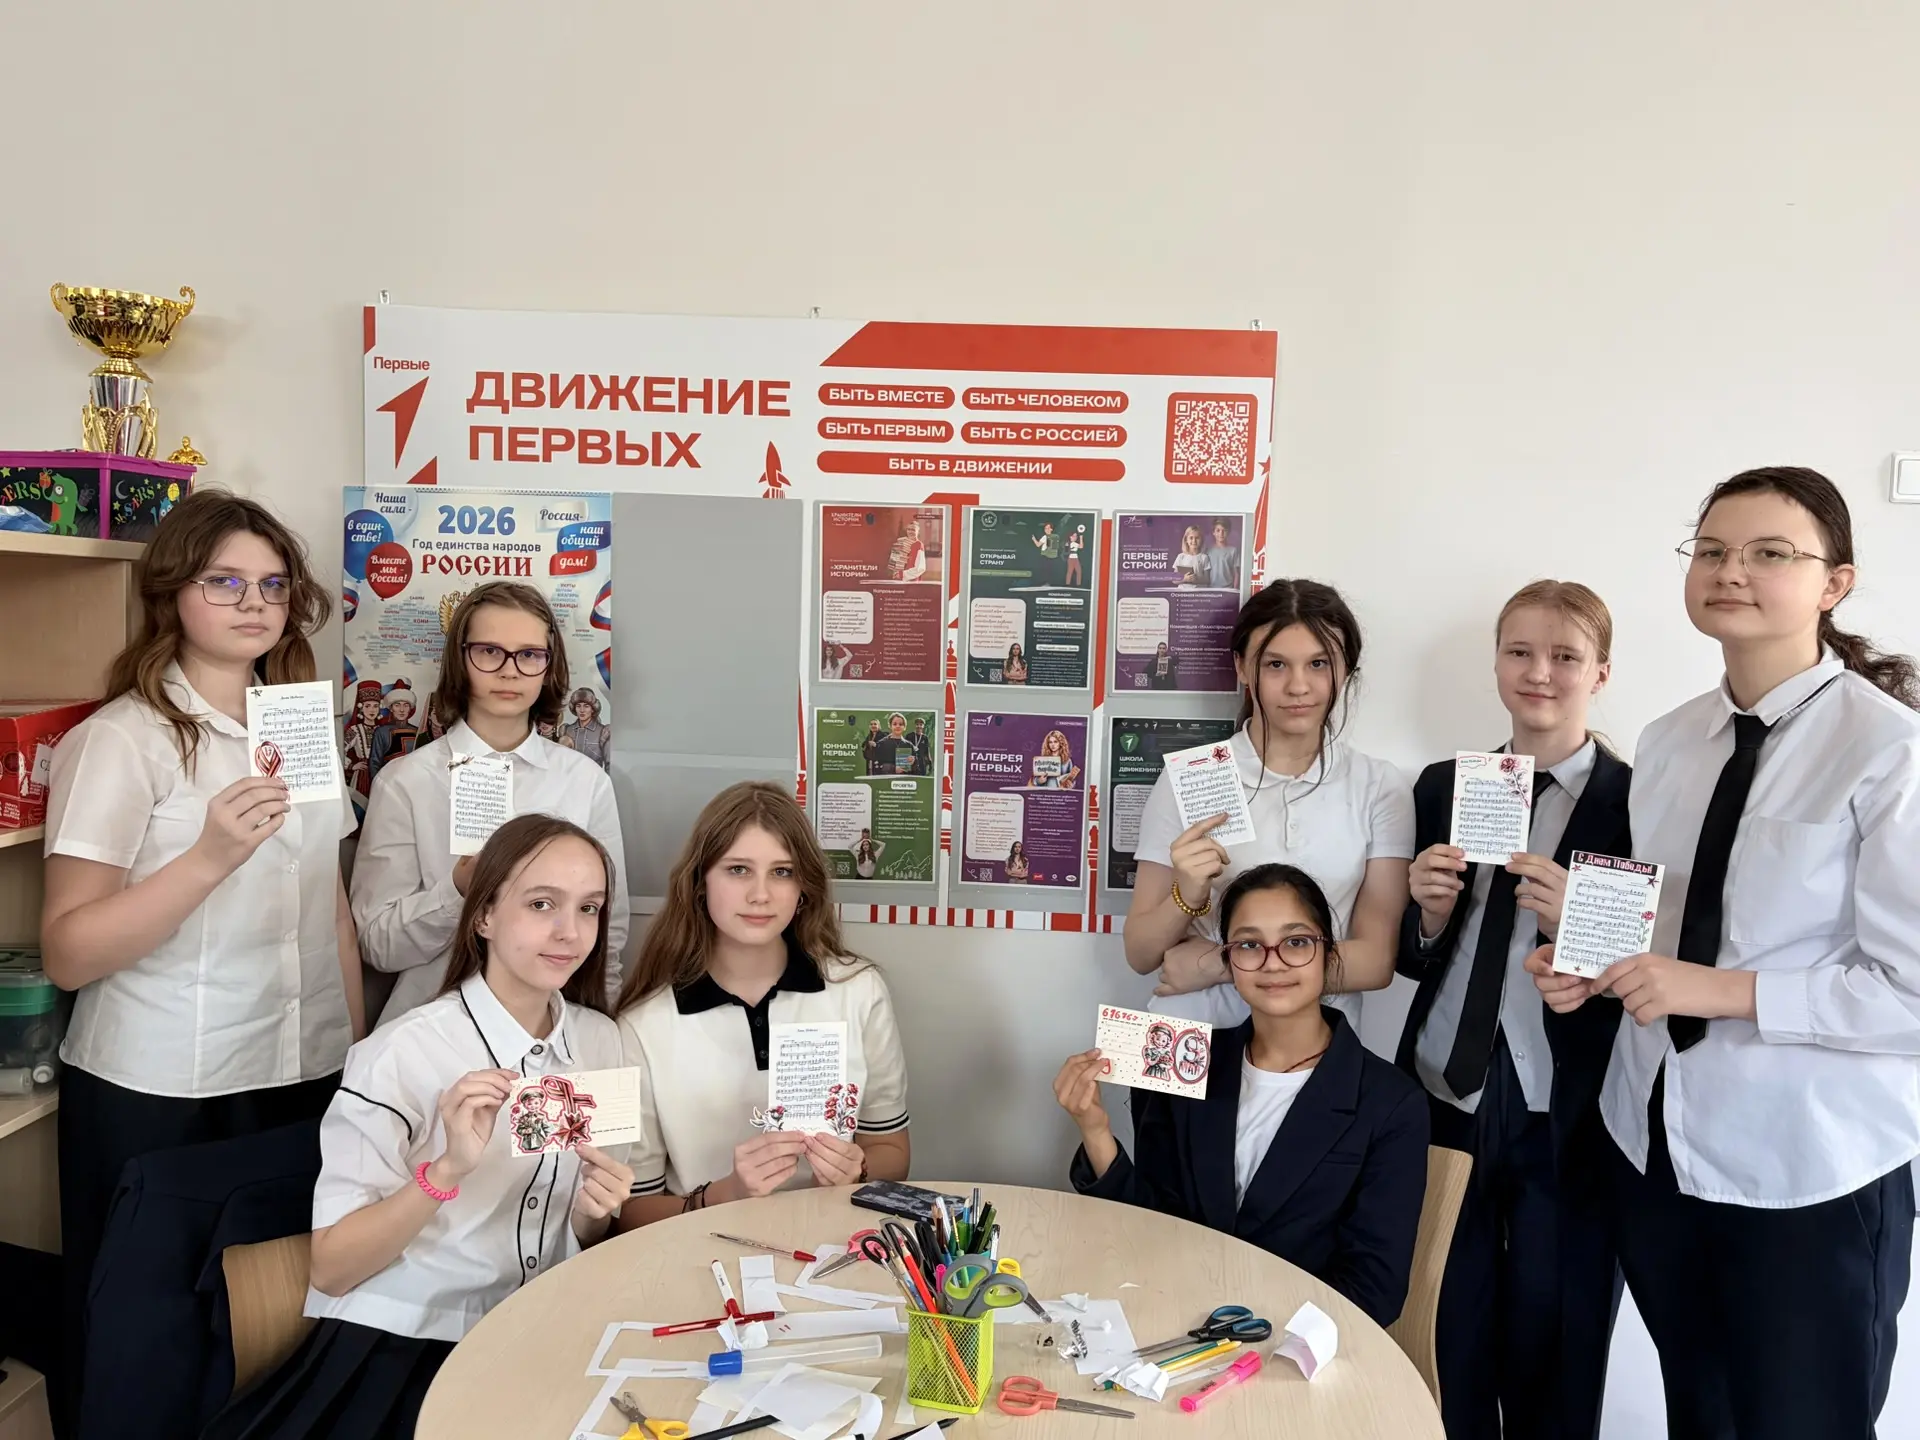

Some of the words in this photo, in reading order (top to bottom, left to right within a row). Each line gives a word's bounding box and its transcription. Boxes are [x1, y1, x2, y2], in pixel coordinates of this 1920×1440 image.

[373, 355, 431, 372] Первые
[466, 370, 791, 417] ДВИЖЕНИЕ
[829, 388, 875, 402] БЫТЬ
[877, 389, 945, 404] ВМЕСТЕ
[969, 391, 1015, 406] БЫТЬ
[1017, 393, 1121, 409] ЧЕЛОВЕКОМ
[825, 422, 872, 436] БЫТЬ
[873, 423, 946, 438] ПЕРВЫМ
[969, 426, 1017, 440] БЫТЬ
[1020, 427, 1032, 441] С
[1034, 427, 1119, 443] РОССИЕЙ
[469, 425, 702, 469] ПЕРВЫХ
[888, 457, 936, 472] БЫТЬ
[939, 459, 951, 473] В
[953, 459, 1053, 475] ДВИЖЕНИИ
[374, 492, 406, 504] Наша
[380, 505, 406, 514] сила
[348, 519, 354, 530] в
[356, 522, 384, 533] един-
[438, 505, 516, 536] 2026
[351, 532, 382, 543] стве!
[580, 526, 604, 535] наш
[412, 538, 433, 551] Год
[436, 540, 489, 551] единства
[492, 542, 541, 553] народов
[561, 534, 600, 548] общий
[370, 554, 407, 565] Вместе
[560, 555, 588, 569] дом!
[1122, 552, 1168, 560] ПЕРВЫЕ
[380, 566, 397, 574] мы
[420, 553, 533, 577] РОССИИ
[1122, 561, 1167, 569] СТРОКИ
[370, 572, 407, 583] Россия!
[971, 752, 1023, 763] ГАЛЕРЕЯ
[970, 763, 1022, 773] ПЕРВЫХ
